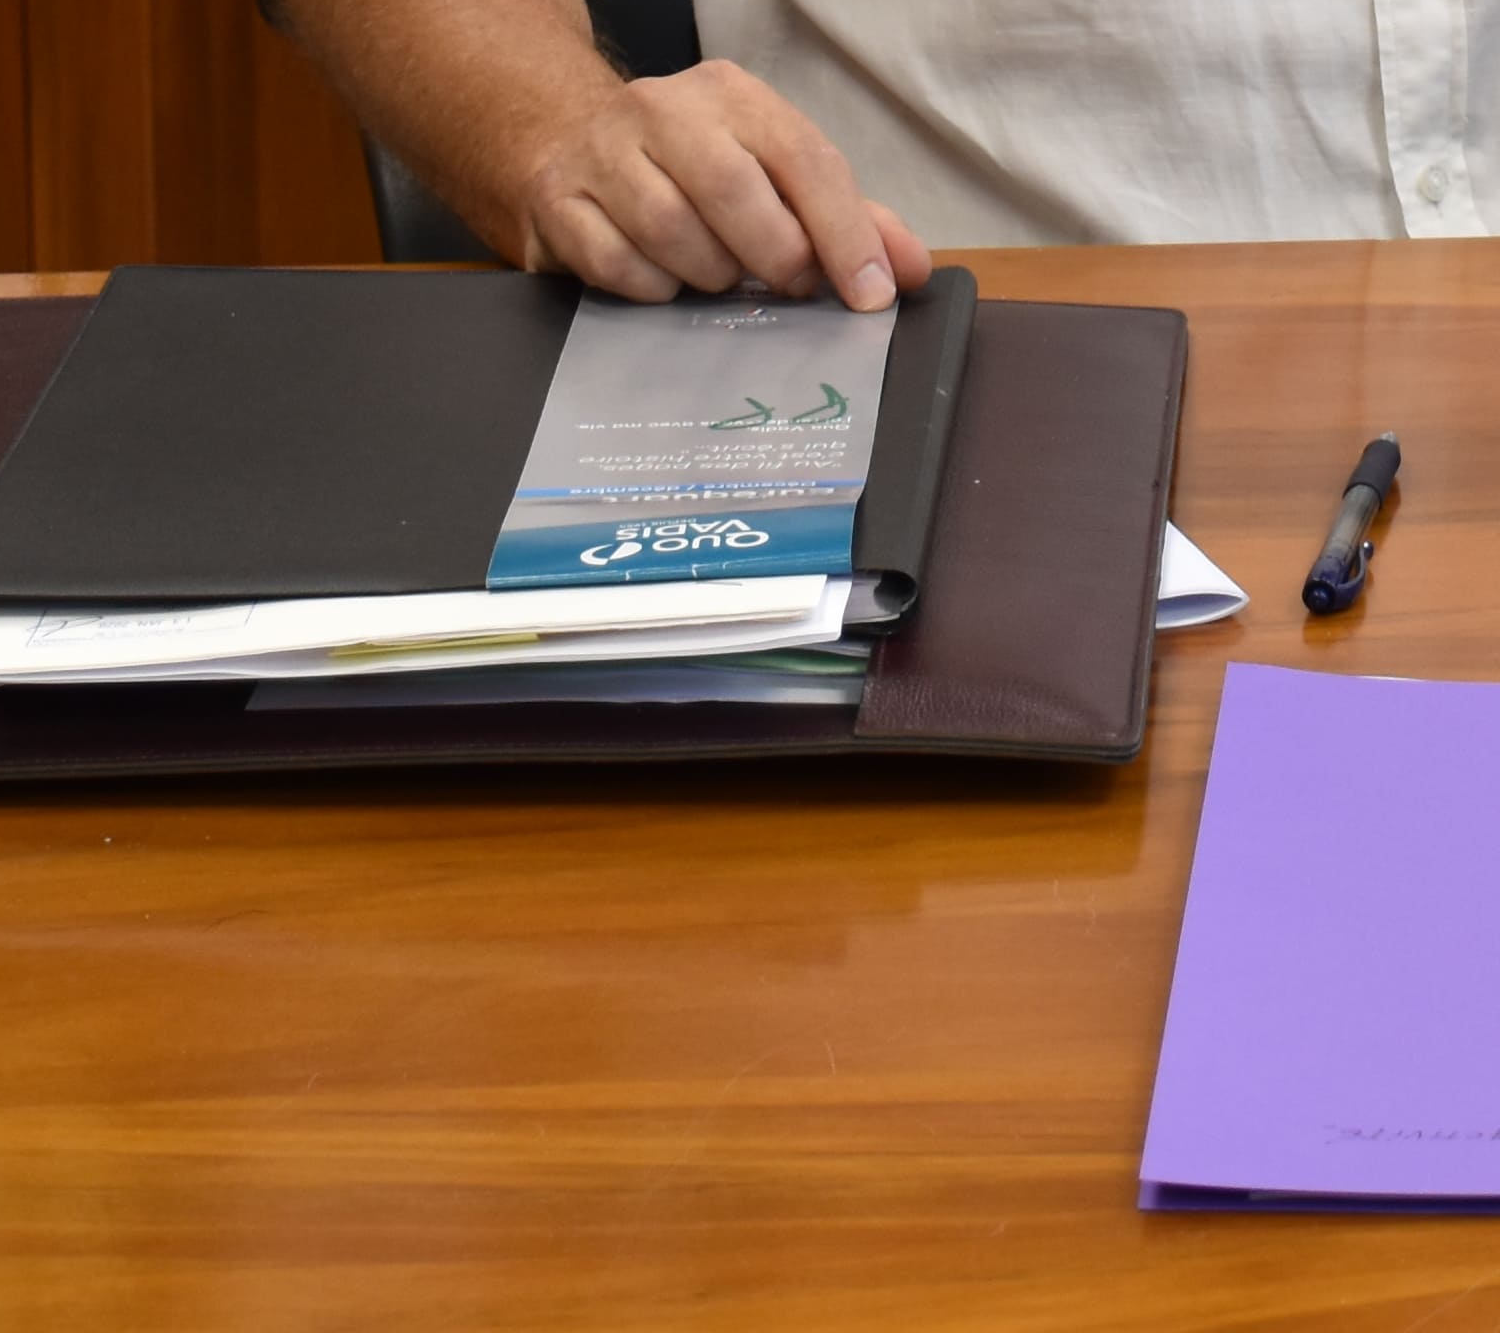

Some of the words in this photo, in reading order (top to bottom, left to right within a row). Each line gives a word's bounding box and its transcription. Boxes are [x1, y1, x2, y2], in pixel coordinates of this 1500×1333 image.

[804, 440, 847, 451] qui
[578, 452, 686, 465] histoire
[696, 451, 758, 461] votre
[699, 461, 742, 472] des
[758, 460, 783, 471] fil
[569, 484, 682, 495] décembre
[615, 518, 752, 541] VADIS
[651, 530, 770, 552] QUO
